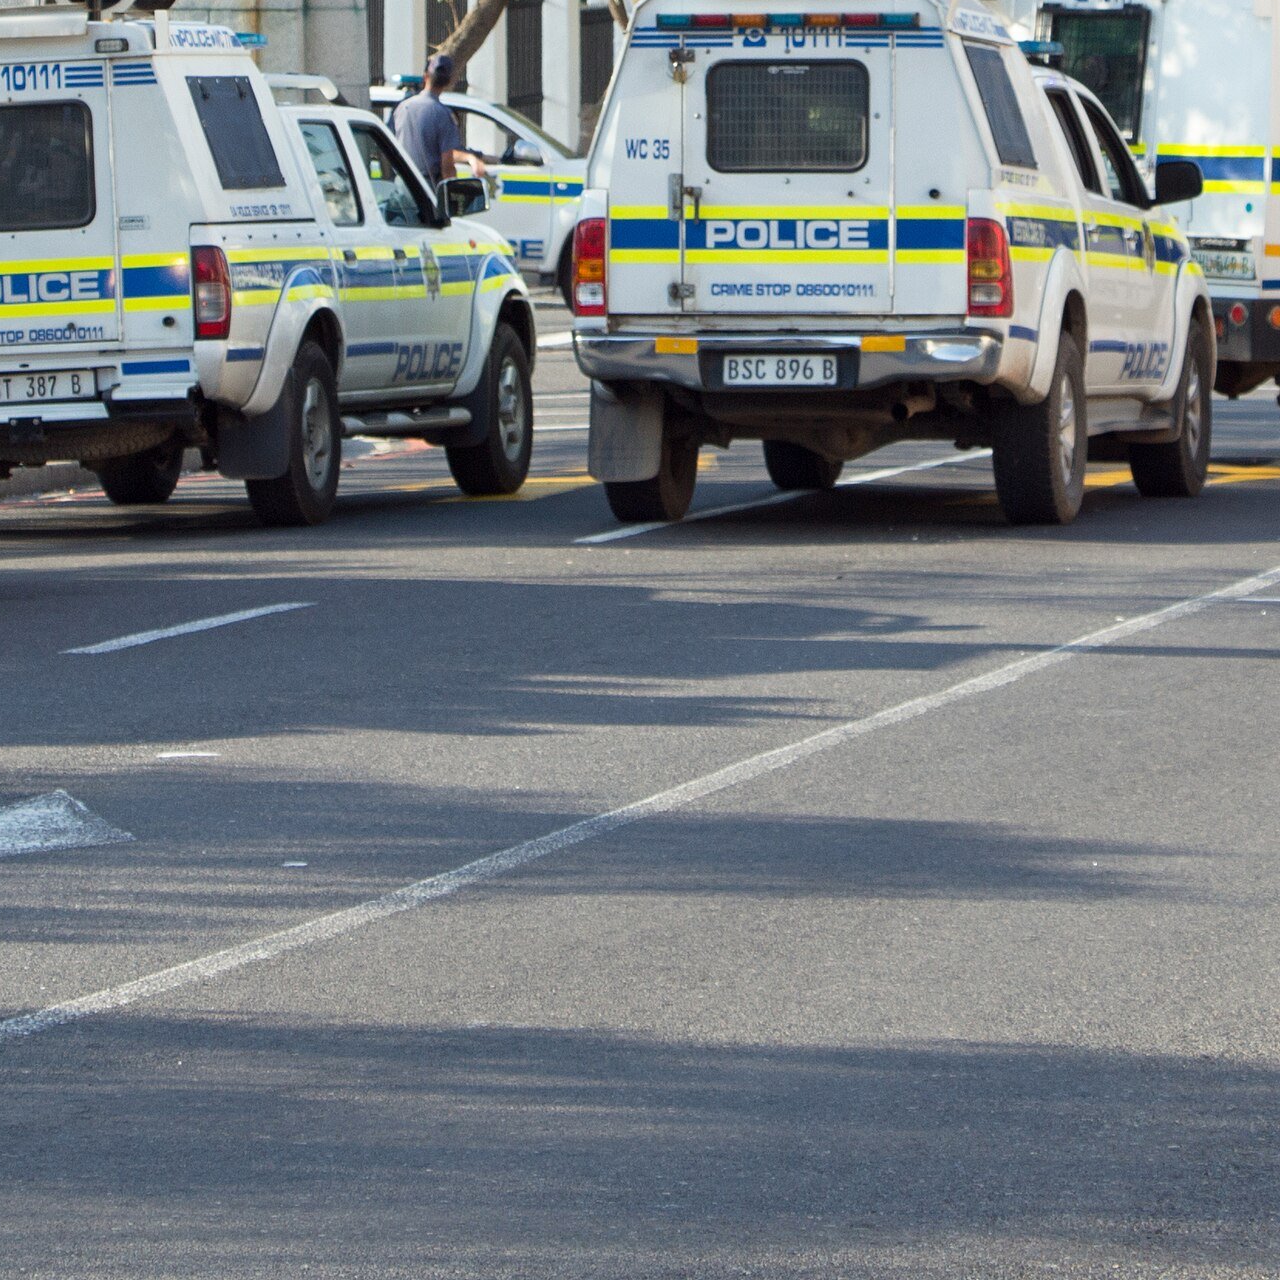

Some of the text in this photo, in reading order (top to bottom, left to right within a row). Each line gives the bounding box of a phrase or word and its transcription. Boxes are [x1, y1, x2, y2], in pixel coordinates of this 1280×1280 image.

[1, 64, 61, 91] 10111
[626, 139, 670, 159] WC 35
[706, 220, 869, 249] POLICE
[711, 283, 874, 297] CRIME STOP 0860010111
[28, 326, 104, 342] 0860010111
[392, 342, 463, 382] POLICE
[728, 359, 834, 380] BSC 896 B
[1120, 343, 1168, 380] POLICE
[26, 376, 57, 398] 387
[71, 374, 81, 395] B
